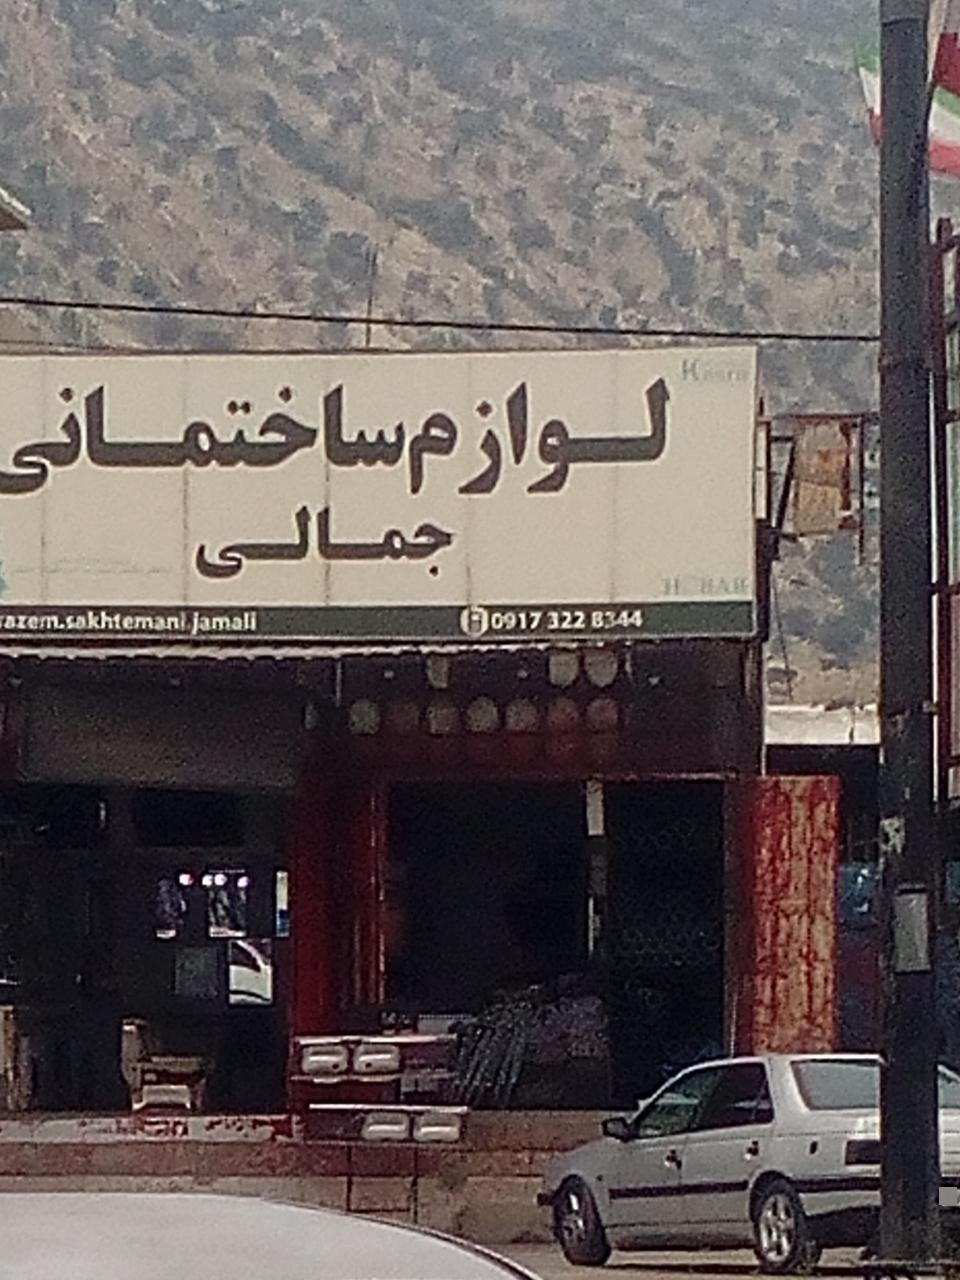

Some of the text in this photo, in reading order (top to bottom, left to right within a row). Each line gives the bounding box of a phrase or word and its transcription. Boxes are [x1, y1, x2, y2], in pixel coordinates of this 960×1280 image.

[409, 376, 671, 495] لوازم
[195, 504, 456, 579] جمالی
[491, 608, 644, 630] 0917 322 8344
